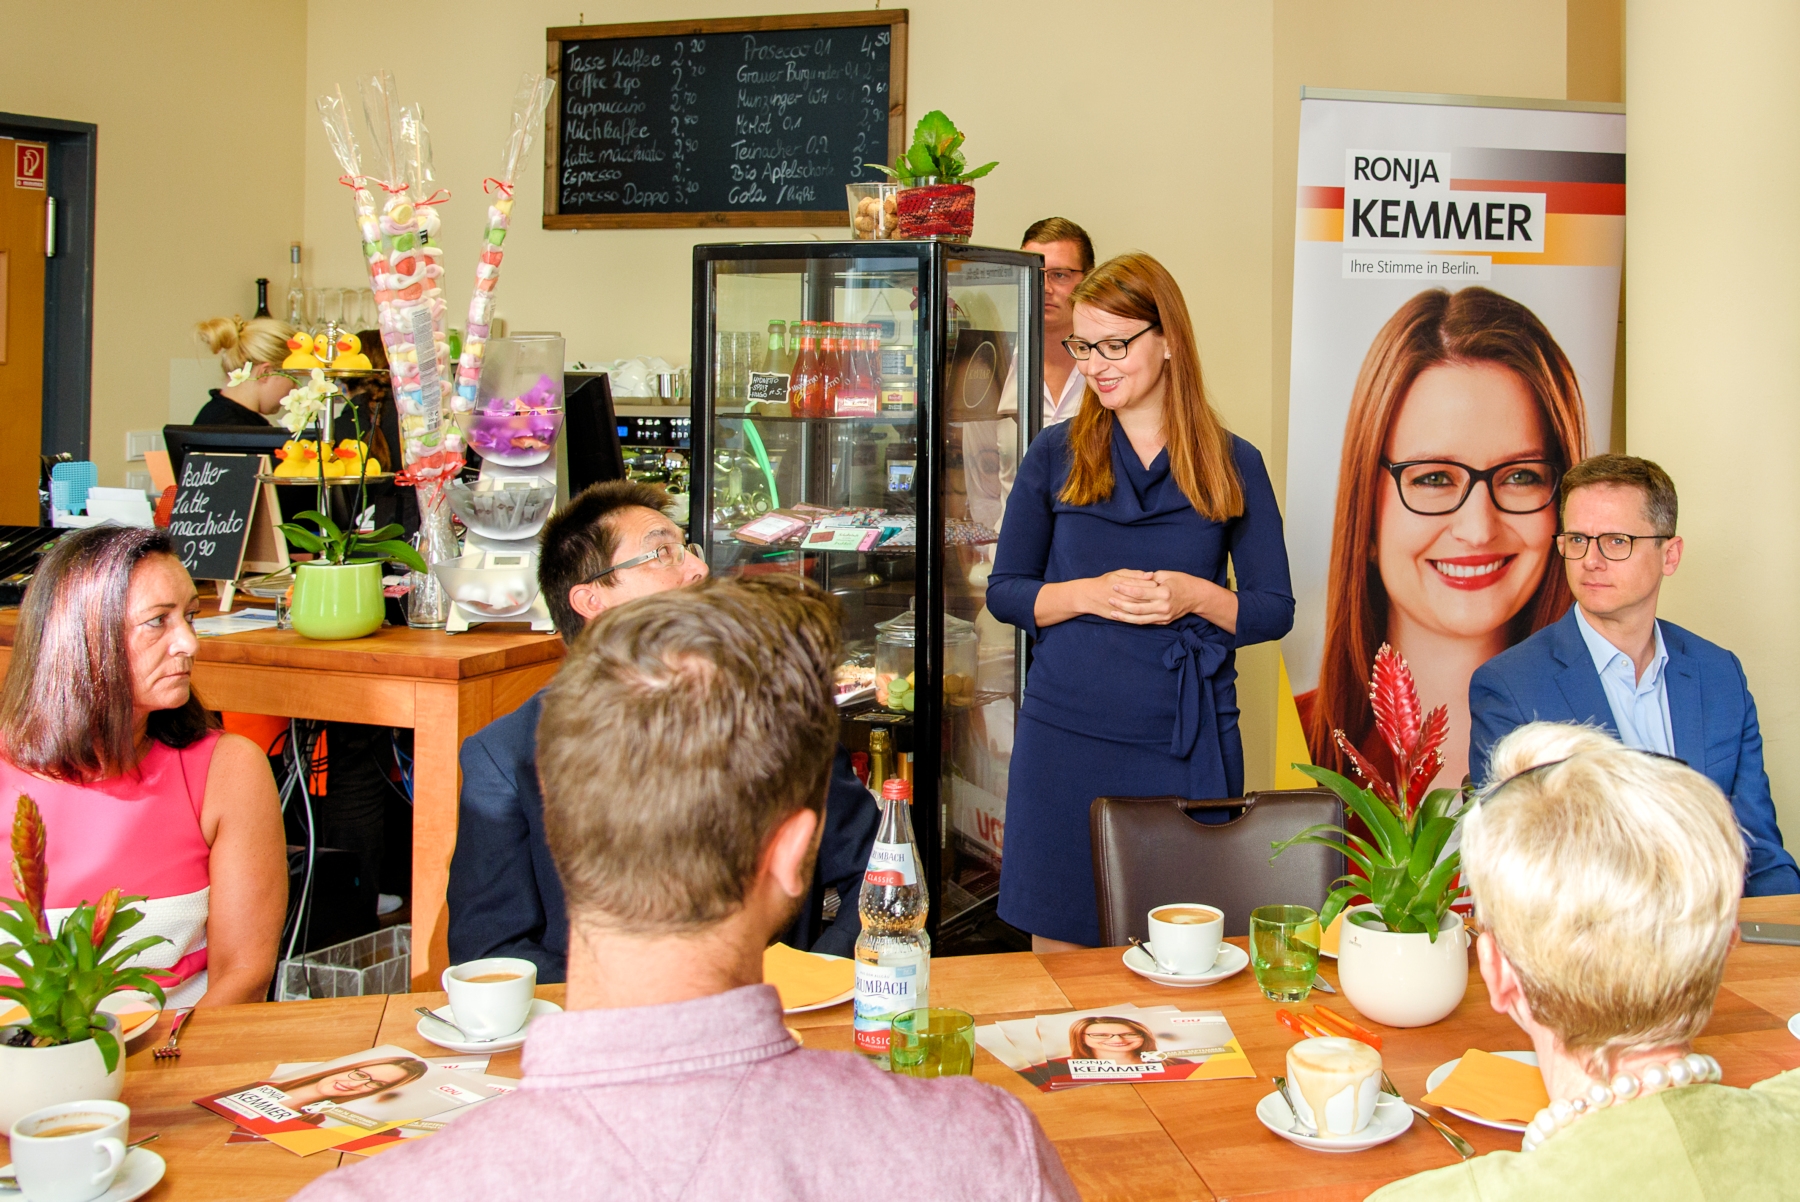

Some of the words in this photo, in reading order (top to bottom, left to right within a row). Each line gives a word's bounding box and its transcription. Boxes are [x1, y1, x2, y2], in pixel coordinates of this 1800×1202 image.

[567, 45, 606, 72] Tasse
[612, 48, 661, 72] Kaffee
[567, 71, 607, 98] Coffee
[567, 96, 646, 119] Cappuccino
[563, 144, 597, 167] Latte
[563, 168, 622, 187] Espresso
[1354, 156, 1440, 189] RONJA
[562, 188, 620, 206] Espresso
[728, 182, 767, 204] Cola
[1352, 198, 1533, 241] KEMMER
[1350, 259, 1373, 274] Ihre
[1377, 260, 1423, 274] Stimme
[1427, 262, 1438, 274] in
[1442, 261, 1479, 275] Berlin.
[182, 461, 231, 487] kalter
[172, 489, 210, 514] Latte
[169, 510, 244, 536] macchiato
[181, 539, 216, 571] 2,90
[867, 873, 894, 884] CLASSIC
[857, 1032, 891, 1045] CLASSIC
[1074, 1065, 1159, 1073] KEMMER
[439, 1085, 463, 1097] CDU
[234, 1091, 292, 1120] KEMMER
